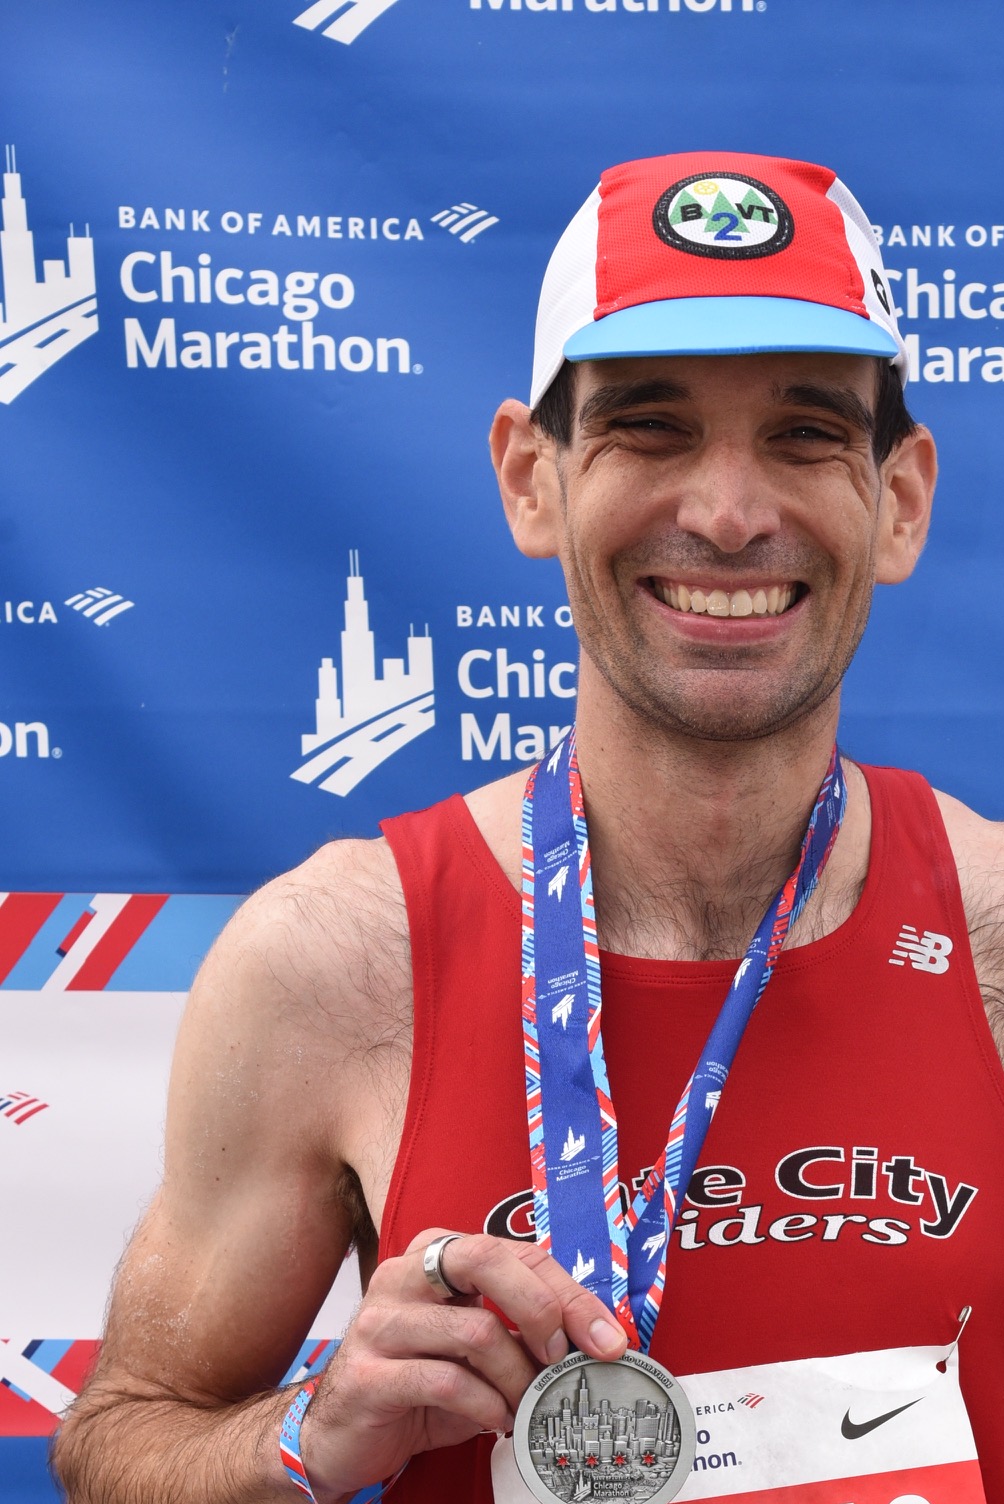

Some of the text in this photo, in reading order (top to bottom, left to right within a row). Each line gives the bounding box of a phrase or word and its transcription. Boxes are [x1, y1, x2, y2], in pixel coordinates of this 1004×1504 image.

[119, 207, 423, 240] BANK OF AMERICA
[870, 225, 955, 247] BANK
[966, 225, 1004, 247] OF
[120, 251, 355, 321] Chicago
[457, 605, 574, 628] BANK O
[457, 648, 577, 699] Chic
[556, 1169, 590, 1181] Marathon
[559, 1165, 587, 1175] Chicago
[774, 1146, 980, 1240] City
[676, 1206, 910, 1251] iders
[564, 1355, 594, 1370] AMERIC
[634, 1358, 674, 1390] MARATHON
[696, 1402, 735, 1416] ERICA
[593, 1481, 623, 1492] Chicago
[593, 1489, 630, 1498] Marathon
